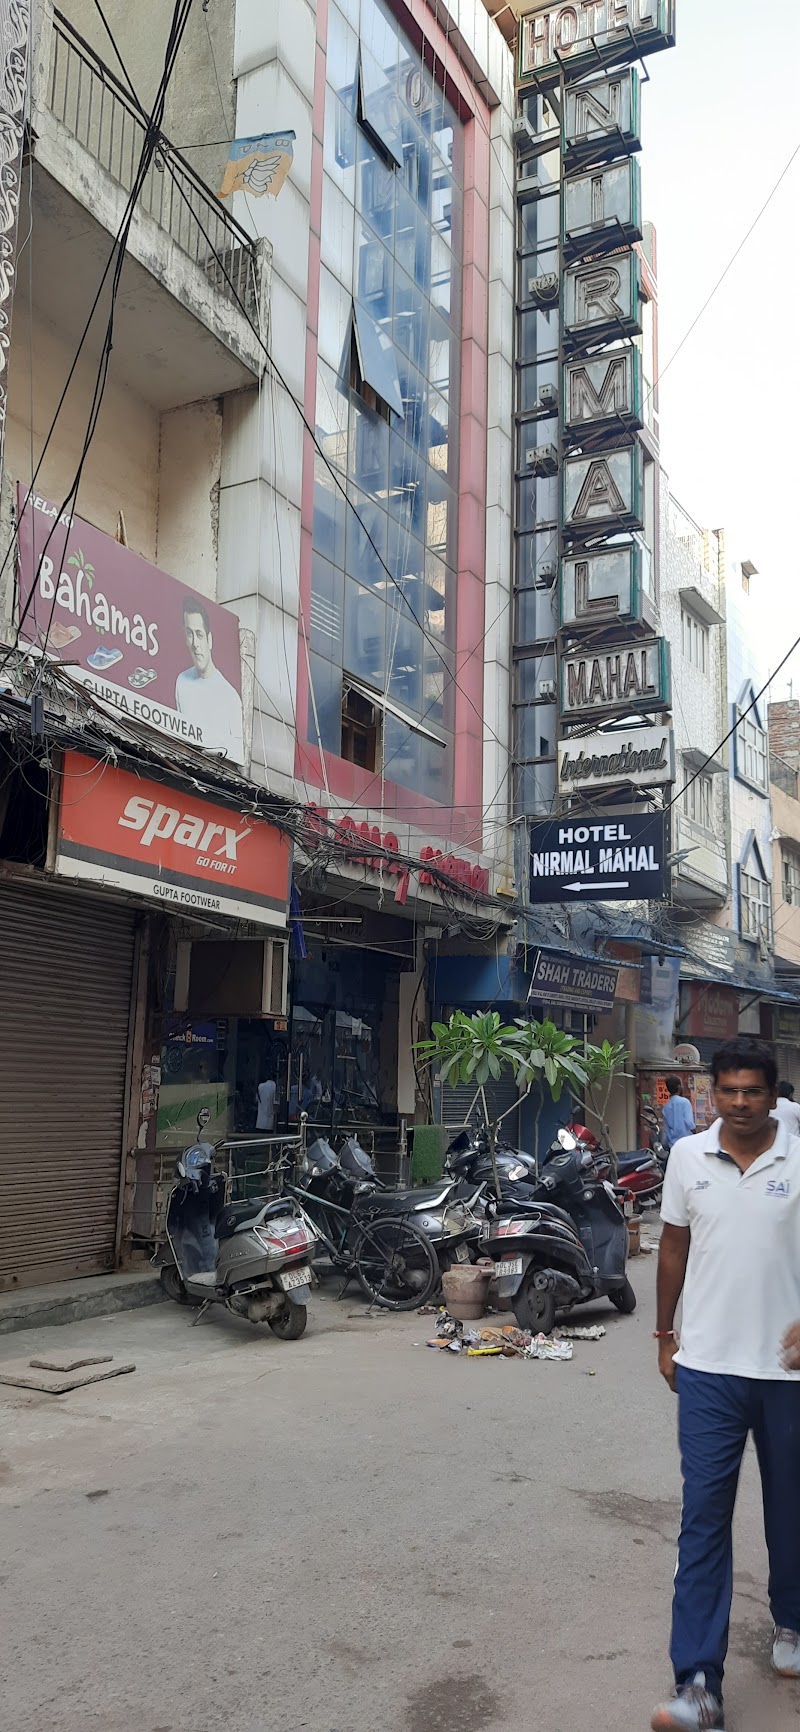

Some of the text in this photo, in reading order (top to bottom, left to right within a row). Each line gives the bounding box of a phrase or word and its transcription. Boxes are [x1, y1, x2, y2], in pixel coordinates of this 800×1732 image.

[526, 0, 654, 67] HOTEL
[24, 490, 75, 529] RELAXO
[39, 554, 159, 656] Bahamas
[567, 650, 656, 706] MAHAL
[133, 699, 203, 742] FOOTWEAR
[560, 738, 667, 781] International
[118, 796, 251, 861] sparx
[558, 823, 632, 844] HOTEL
[196, 856, 237, 874] GO FOR IT
[533, 845, 660, 877] NIRMAL MAHAL
[153, 884, 221, 911] GUPTA FOOTWEAR
[537, 961, 570, 984] SHAH
[572, 968, 616, 993] TRADERS
